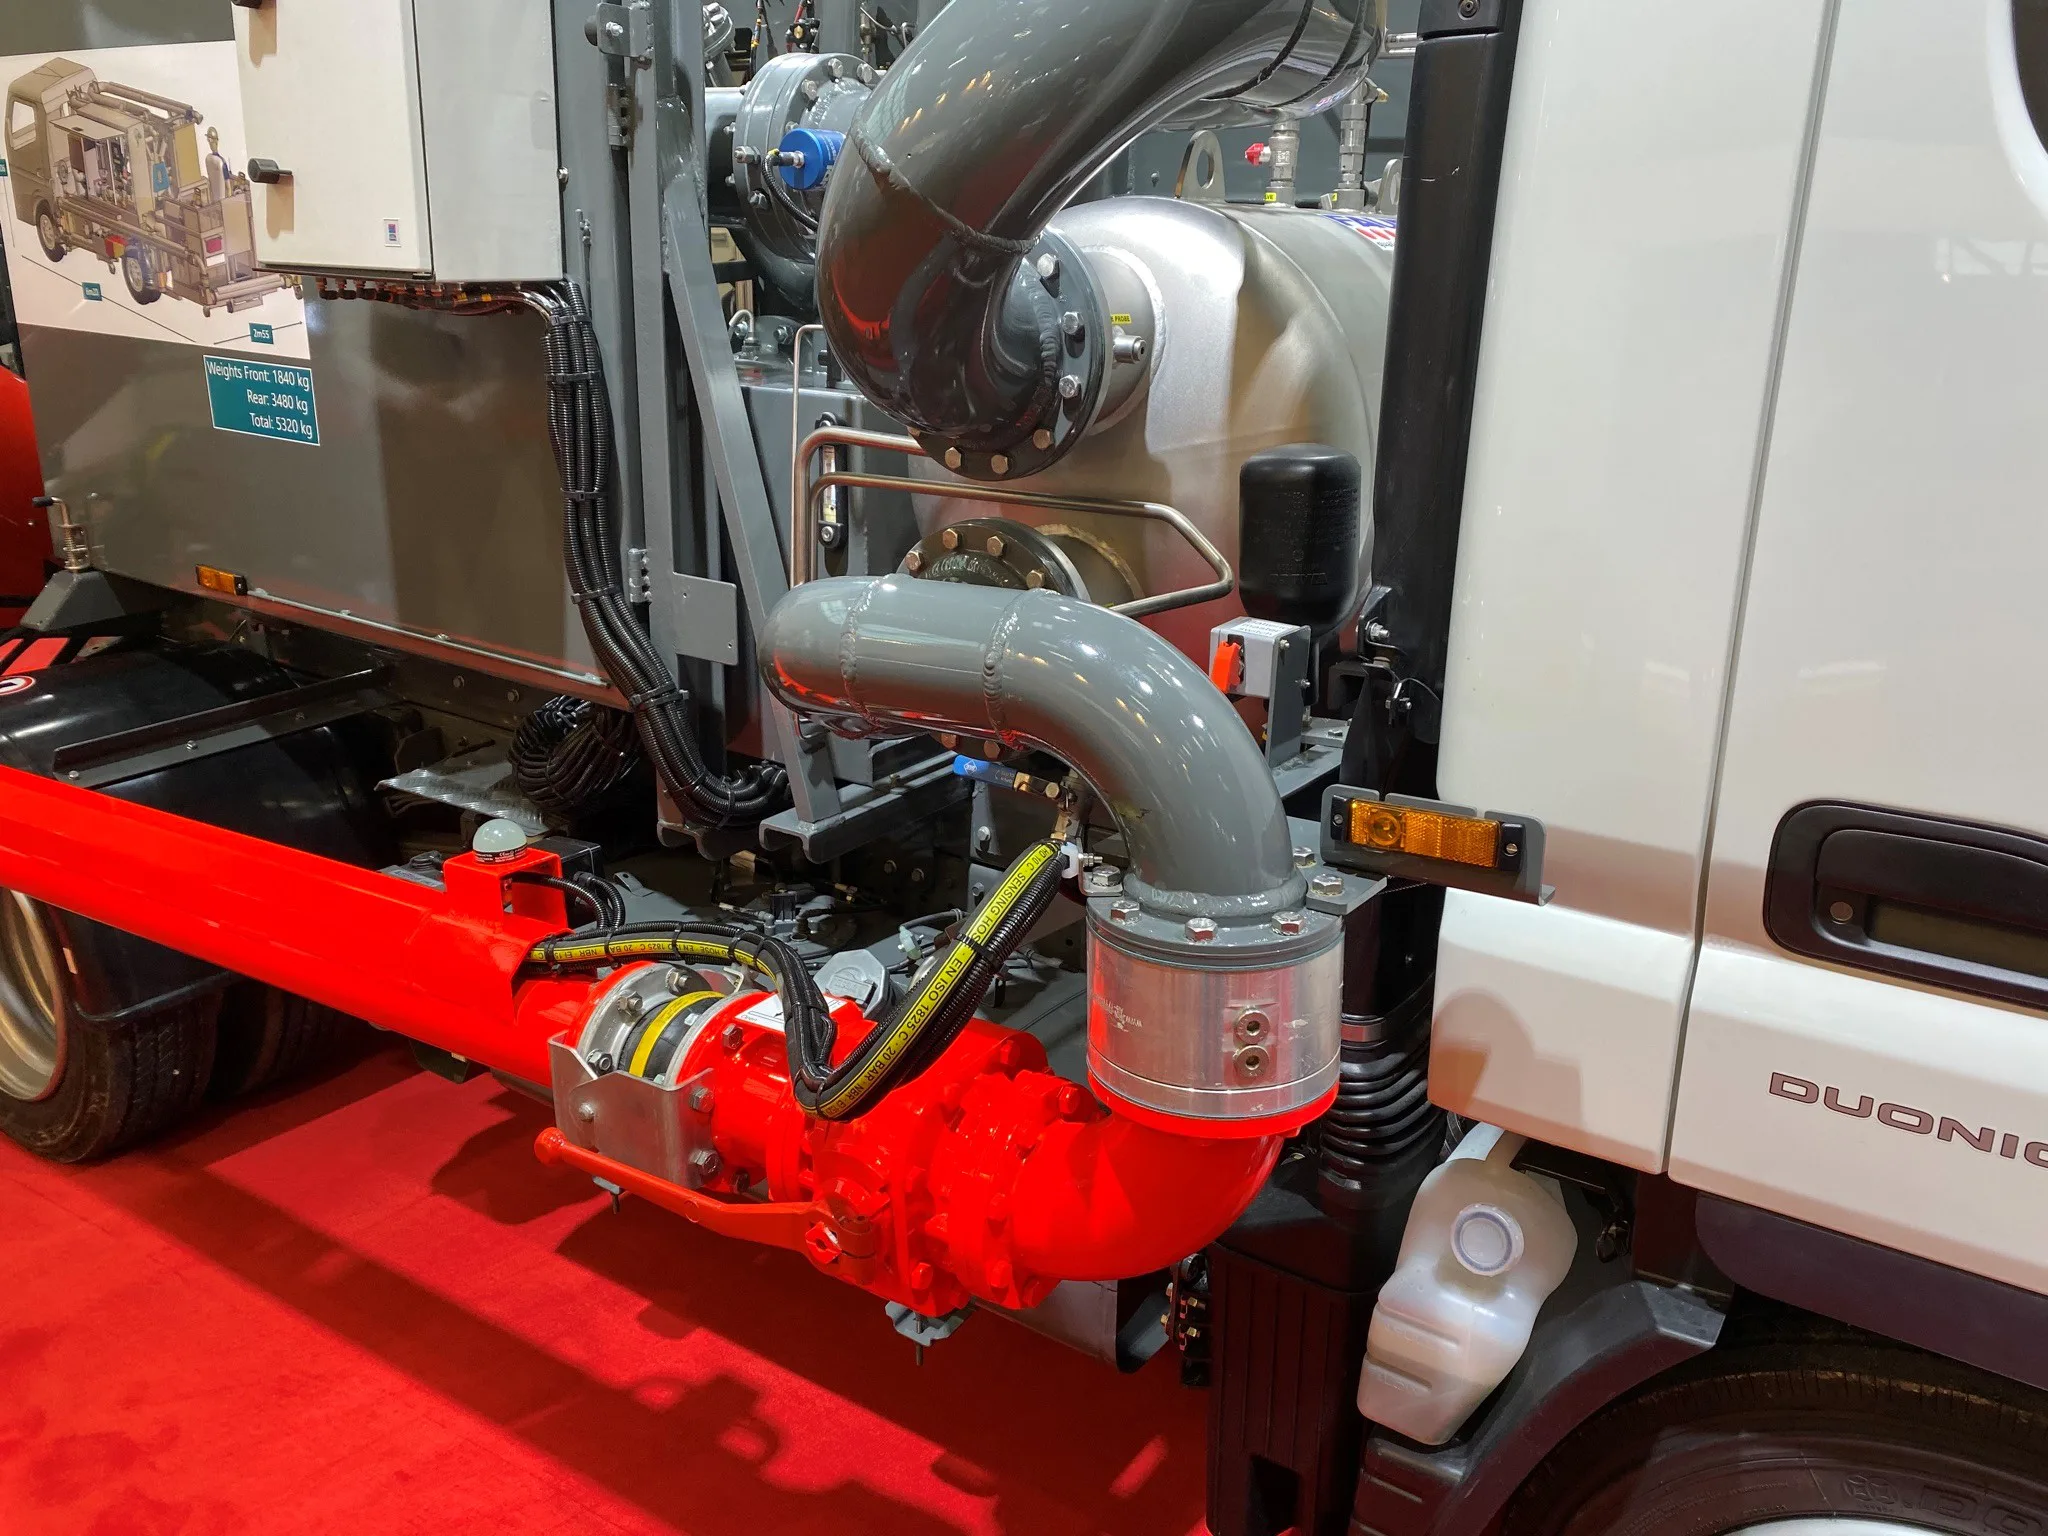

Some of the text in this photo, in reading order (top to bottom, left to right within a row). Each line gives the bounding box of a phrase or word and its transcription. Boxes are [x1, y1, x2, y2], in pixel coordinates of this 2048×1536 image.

[252, 328, 270, 339] 2m55
[206, 361, 310, 392] Weights Front: 1840 kg
[247, 389, 309, 415] Rear: 3480 kg
[249, 412, 313, 439] Total: 5320 kg
[1026, 863, 1035, 871] C
[990, 872, 1026, 916] SENSING
[972, 915, 993, 942] HOS
[579, 948, 598, 957] NBR
[610, 946, 621, 954] BA
[623, 944, 633, 952] 20
[683, 944, 694, 952] EN
[701, 946, 721, 955] HOSE
[945, 958, 963, 978] EN
[928, 978, 948, 1002] ISO
[906, 1004, 930, 1031] 1825
[898, 1031, 909, 1041] C
[882, 1046, 896, 1061] 20
[864, 1061, 886, 1082] BAR
[846, 1084, 866, 1100] NBR
